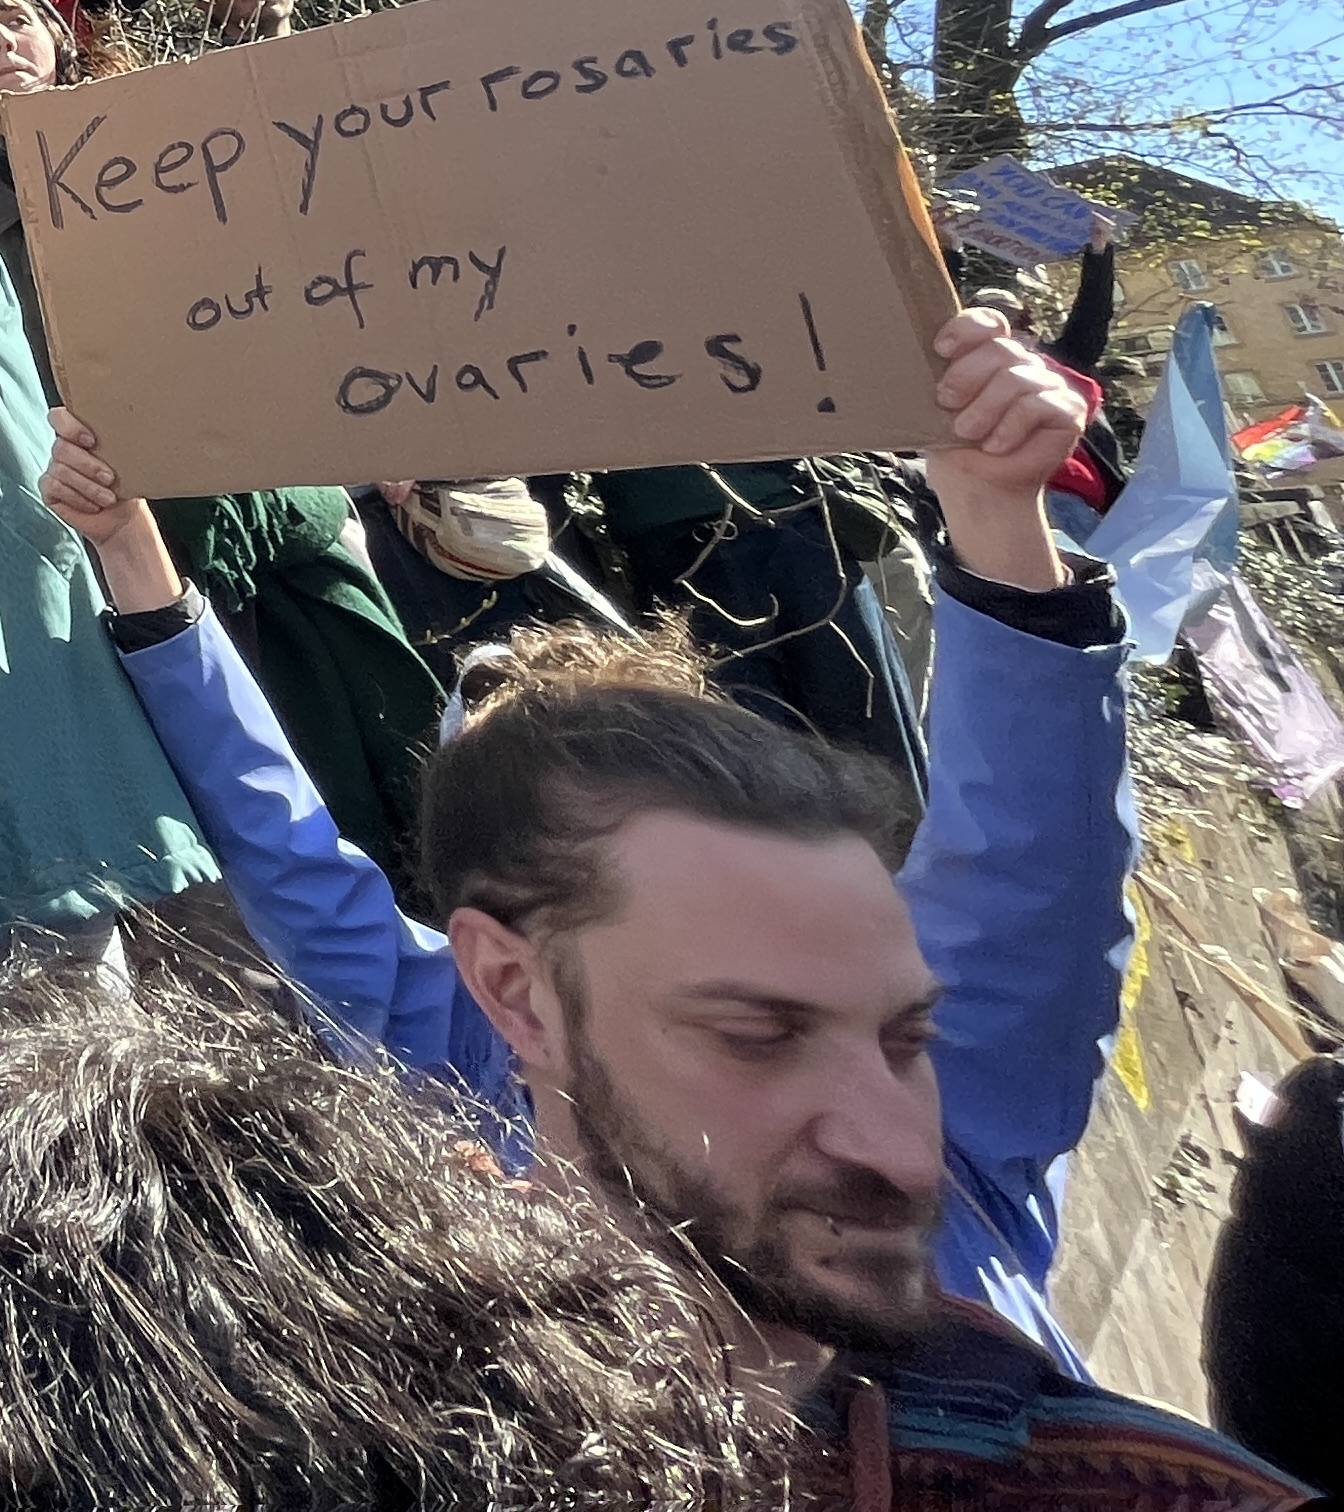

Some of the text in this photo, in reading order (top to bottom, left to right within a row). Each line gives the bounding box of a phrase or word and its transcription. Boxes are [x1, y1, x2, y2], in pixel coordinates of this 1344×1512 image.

[36, 17, 798, 230] Keep your rosaries
[186, 245, 507, 331] out of my
